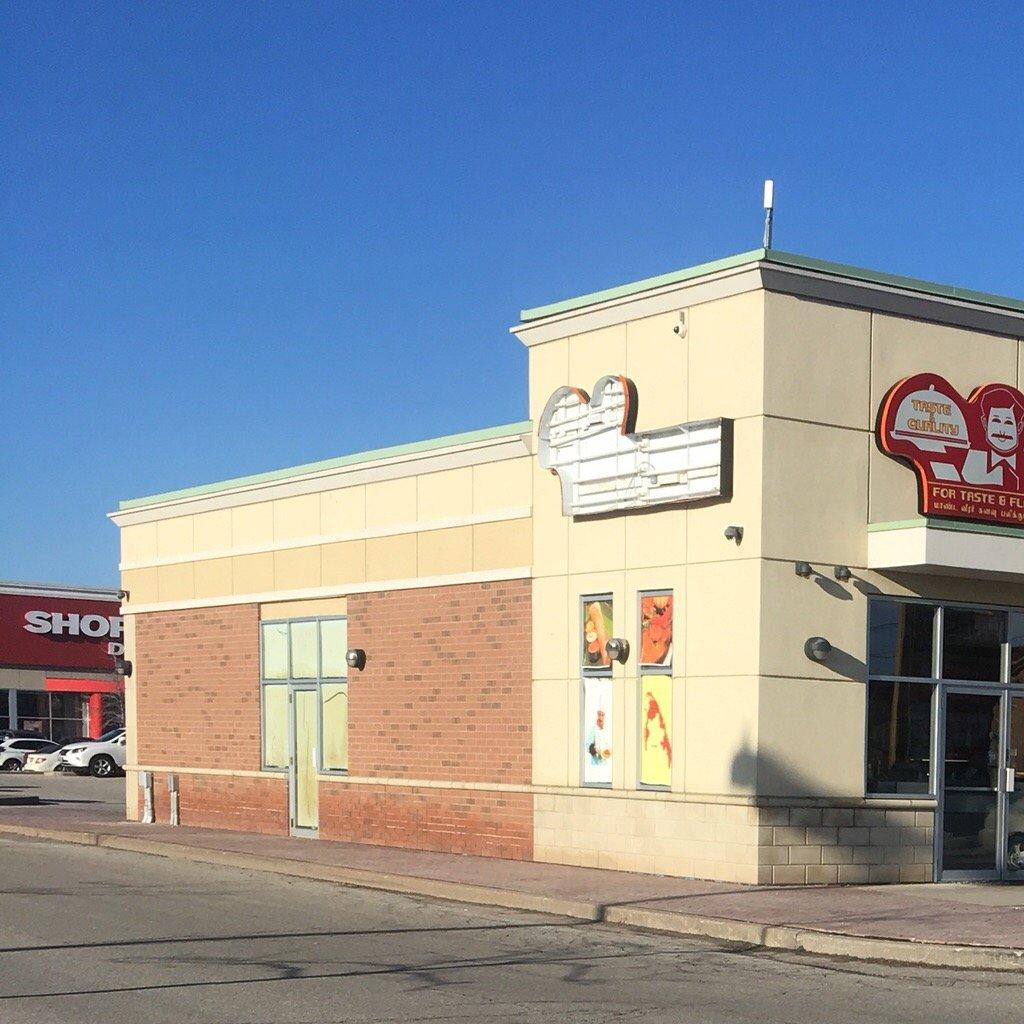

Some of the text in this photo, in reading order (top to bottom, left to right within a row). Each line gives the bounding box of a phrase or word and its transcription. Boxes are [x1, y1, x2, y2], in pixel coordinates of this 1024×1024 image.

[911, 399, 951, 416] TASTE
[907, 418, 959, 436] QUALITY
[932, 487, 956, 499] FOR
[960, 490, 995, 504] TASTE
[999, 495, 1006, 506] &
